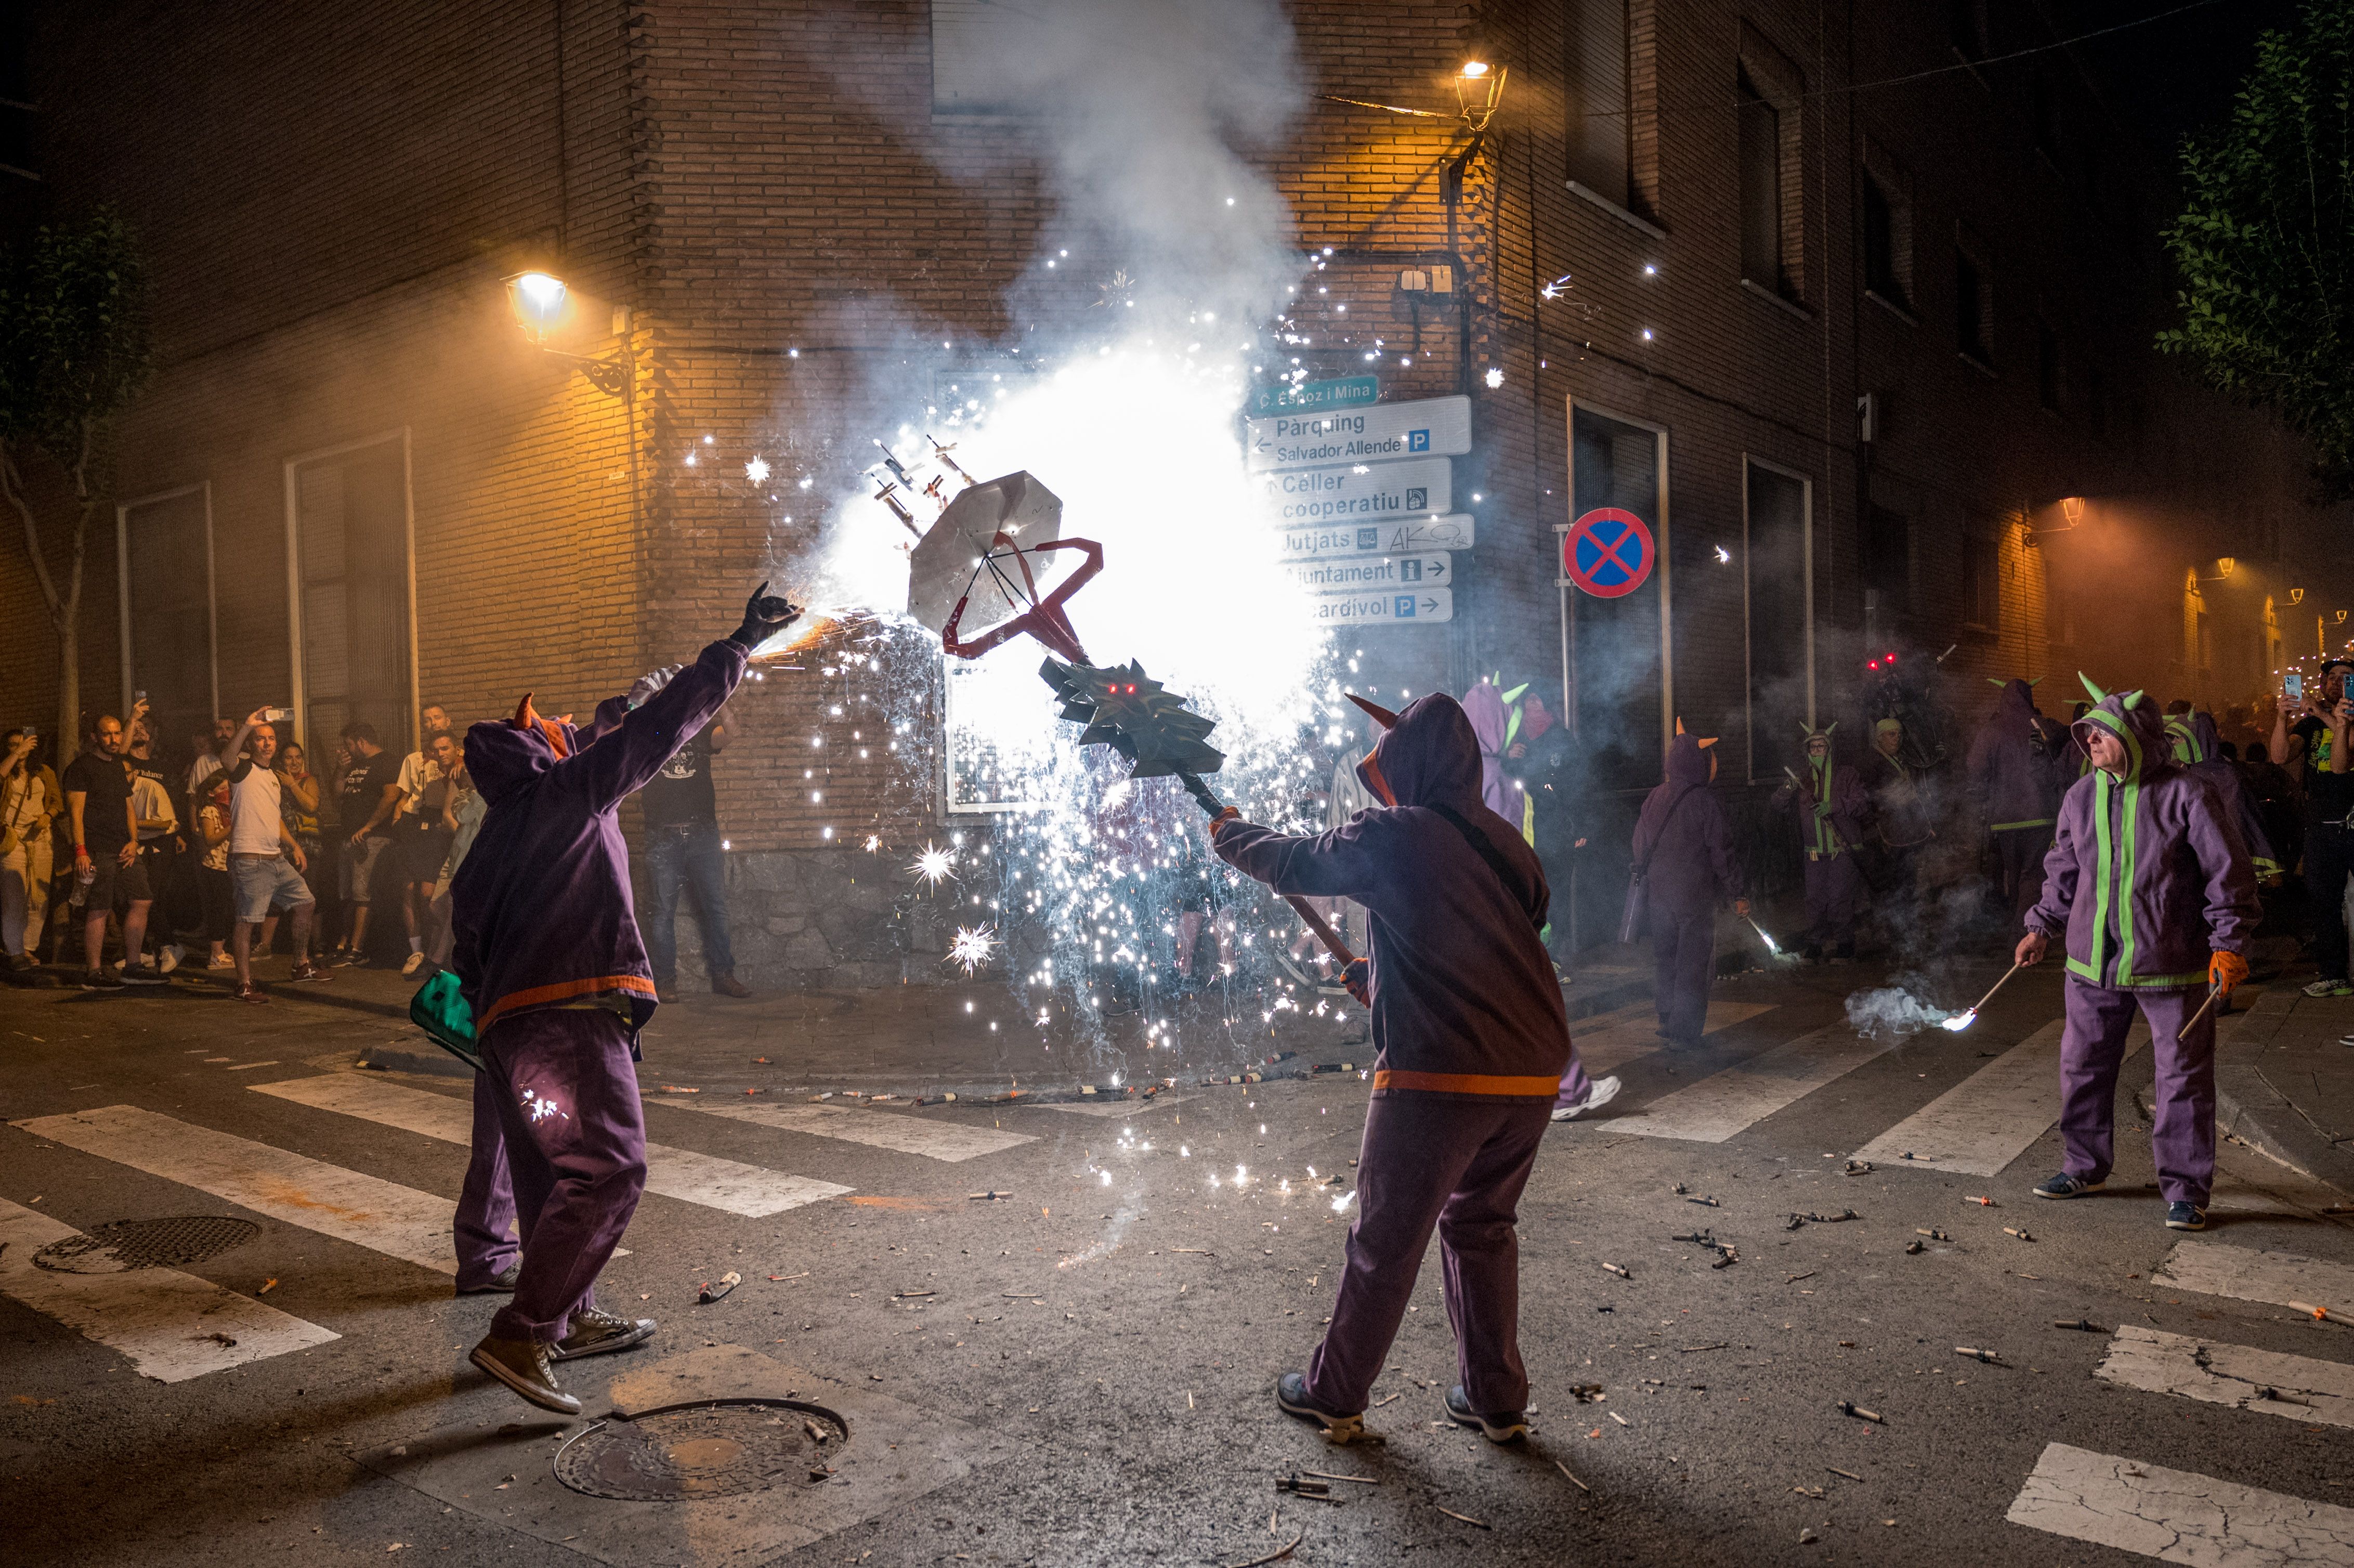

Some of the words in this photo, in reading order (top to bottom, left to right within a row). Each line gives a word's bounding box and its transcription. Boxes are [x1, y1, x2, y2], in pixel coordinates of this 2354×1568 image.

[1260, 394, 1273, 407] C.
[1278, 391, 1323, 407] Espoz
[1327, 388, 1330, 400] i
[1335, 385, 1370, 399] Mina
[1277, 414, 1364, 438] Pàrquing
[1278, 445, 1342, 462] Salvador
[1345, 438, 1401, 456] Allende
[1283, 473, 1344, 493] Celler
[1283, 493, 1399, 519] cooperatiu
[1283, 531, 1350, 554] Jutjats
